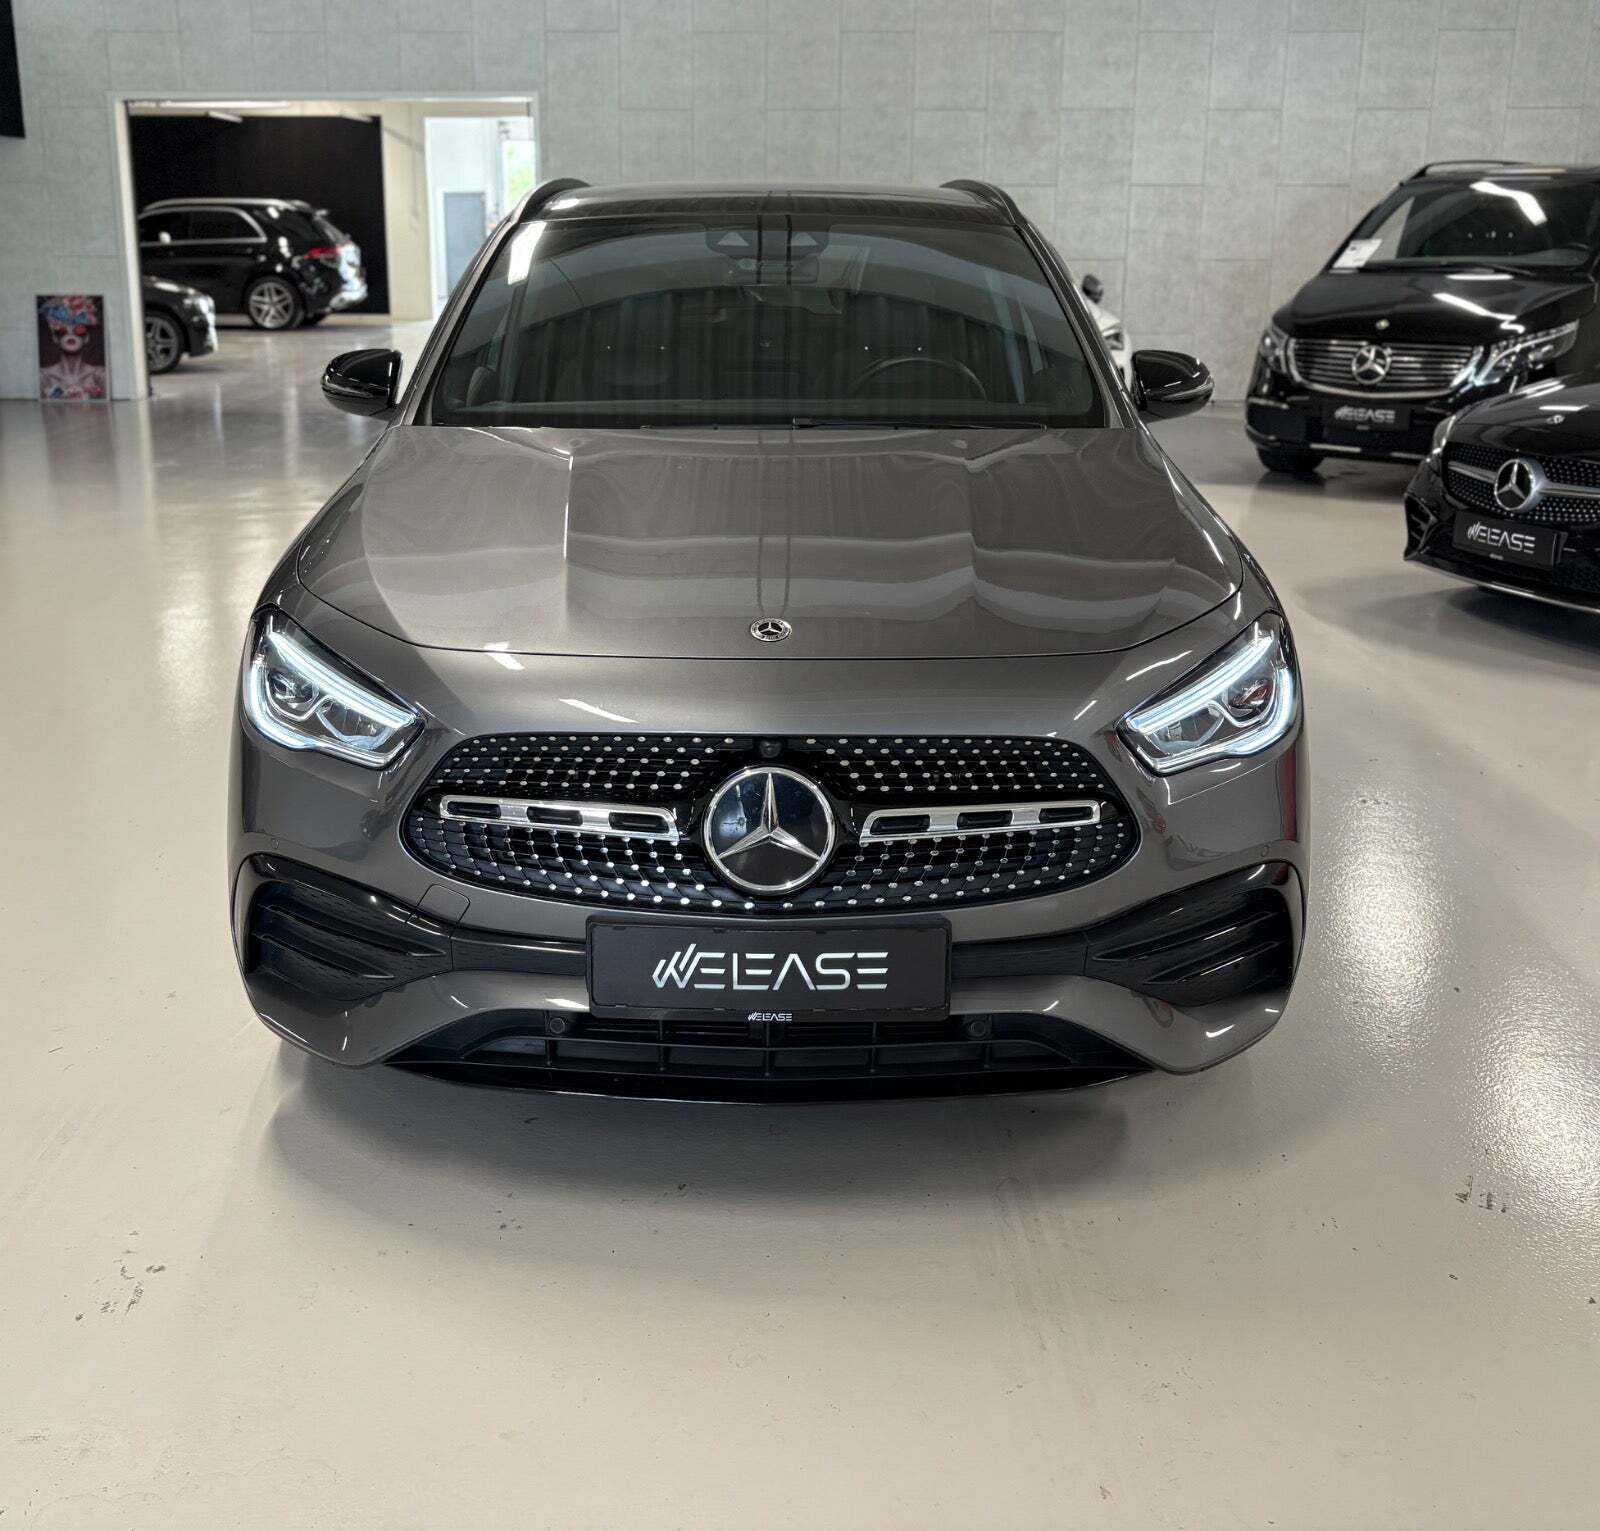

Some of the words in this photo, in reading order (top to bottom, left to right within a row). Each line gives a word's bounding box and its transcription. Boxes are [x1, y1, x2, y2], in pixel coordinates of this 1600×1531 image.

[1334, 405, 1396, 423] WELEASE
[1467, 521, 1536, 554] WELEASE
[652, 943, 889, 991] WELEASE
[748, 1011, 793, 1022] WELEASE
